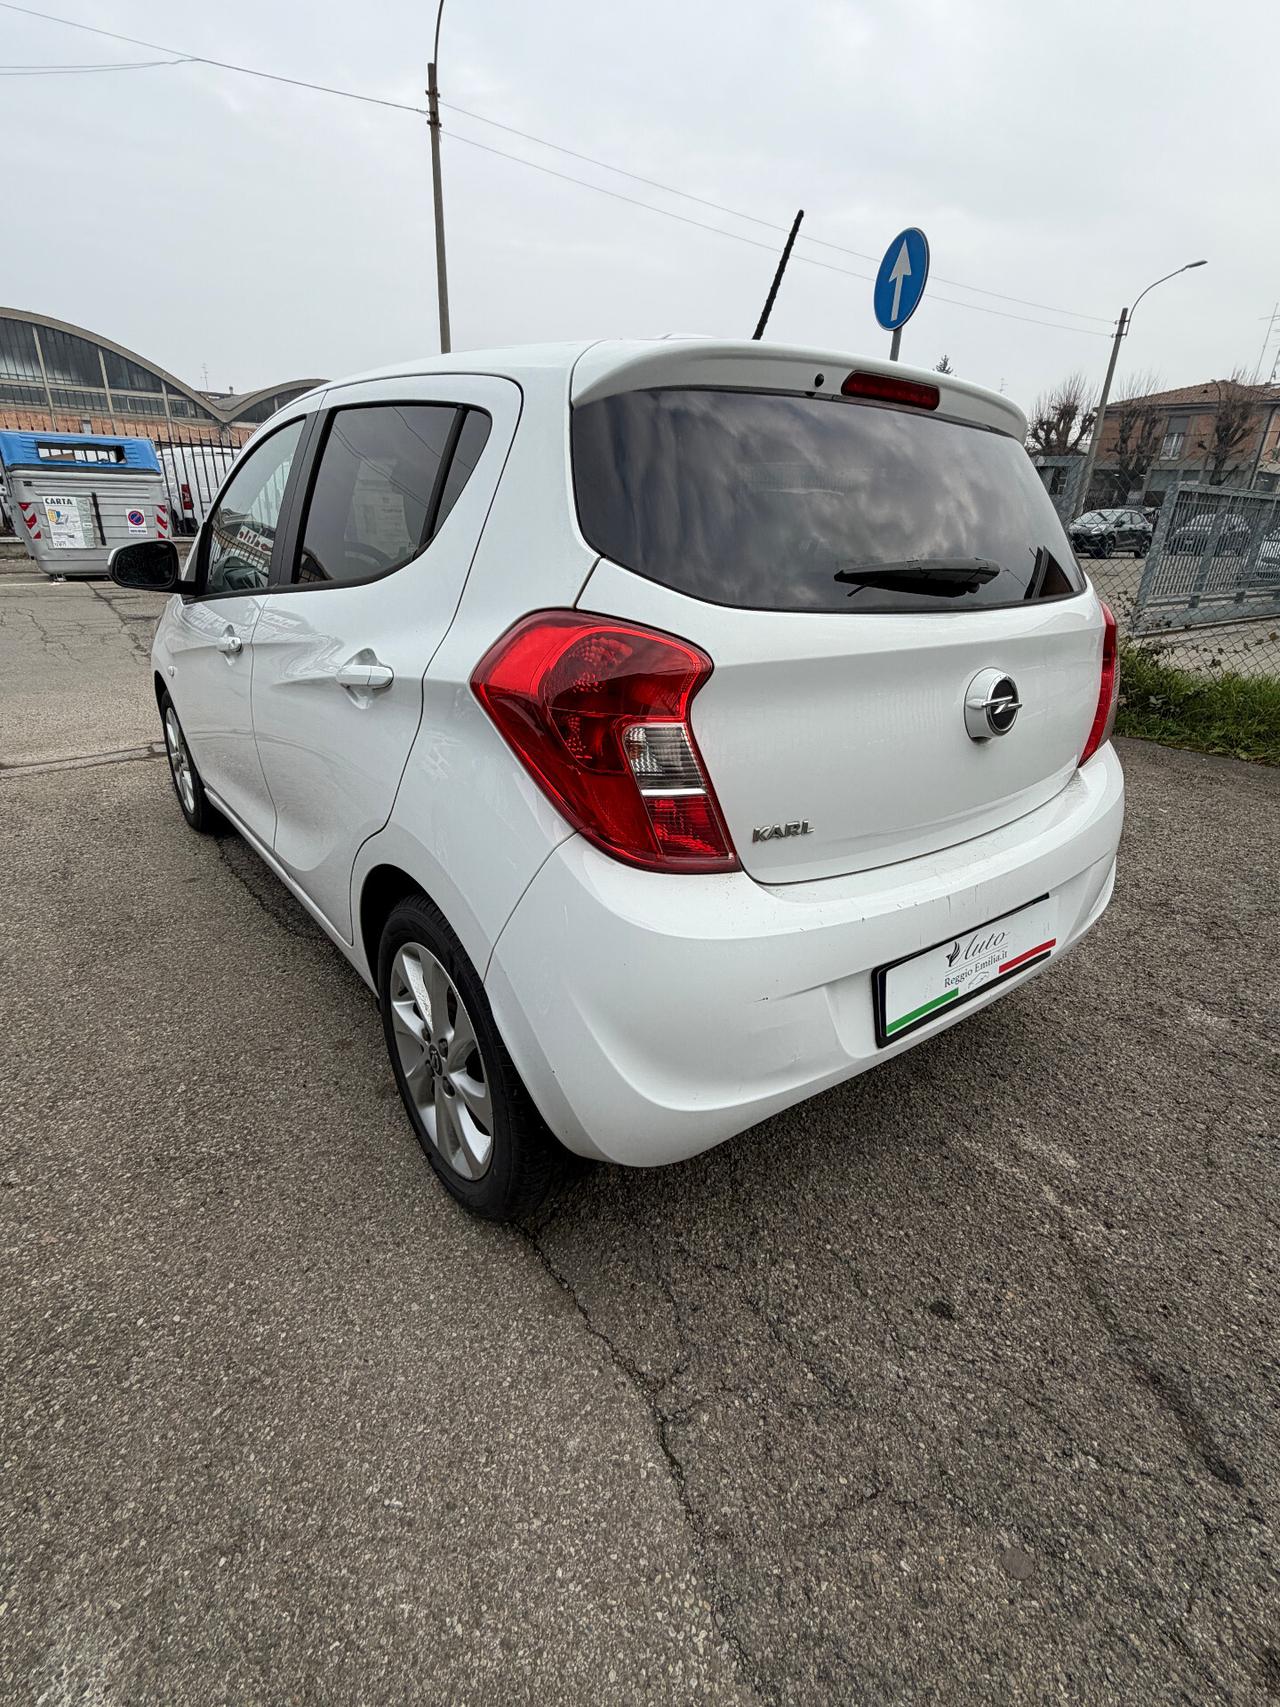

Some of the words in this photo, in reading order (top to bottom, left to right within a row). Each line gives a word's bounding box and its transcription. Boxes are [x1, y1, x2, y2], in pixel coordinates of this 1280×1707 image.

[752, 820, 815, 843] KARL
[944, 969, 973, 988] Reggio
[974, 951, 1008, 972] Emilia.it
